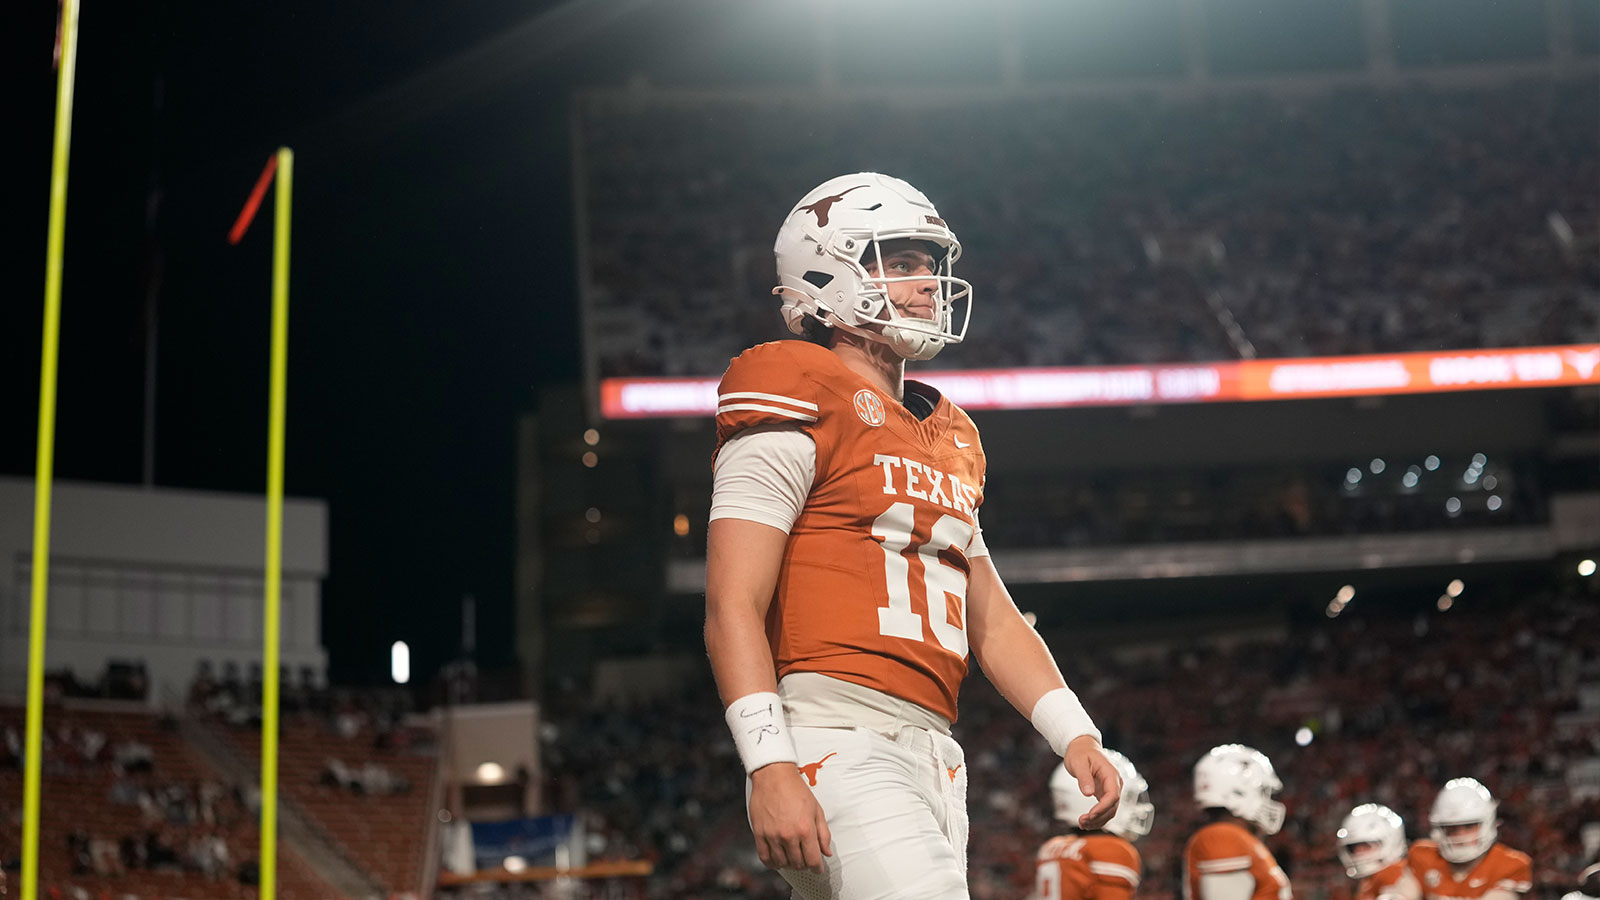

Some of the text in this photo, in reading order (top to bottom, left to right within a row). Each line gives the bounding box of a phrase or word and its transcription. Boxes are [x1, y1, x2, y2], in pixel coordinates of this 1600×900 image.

[856, 391, 883, 424] SEC
[873, 453, 976, 519] TEXAS
[871, 501, 974, 660] 16
